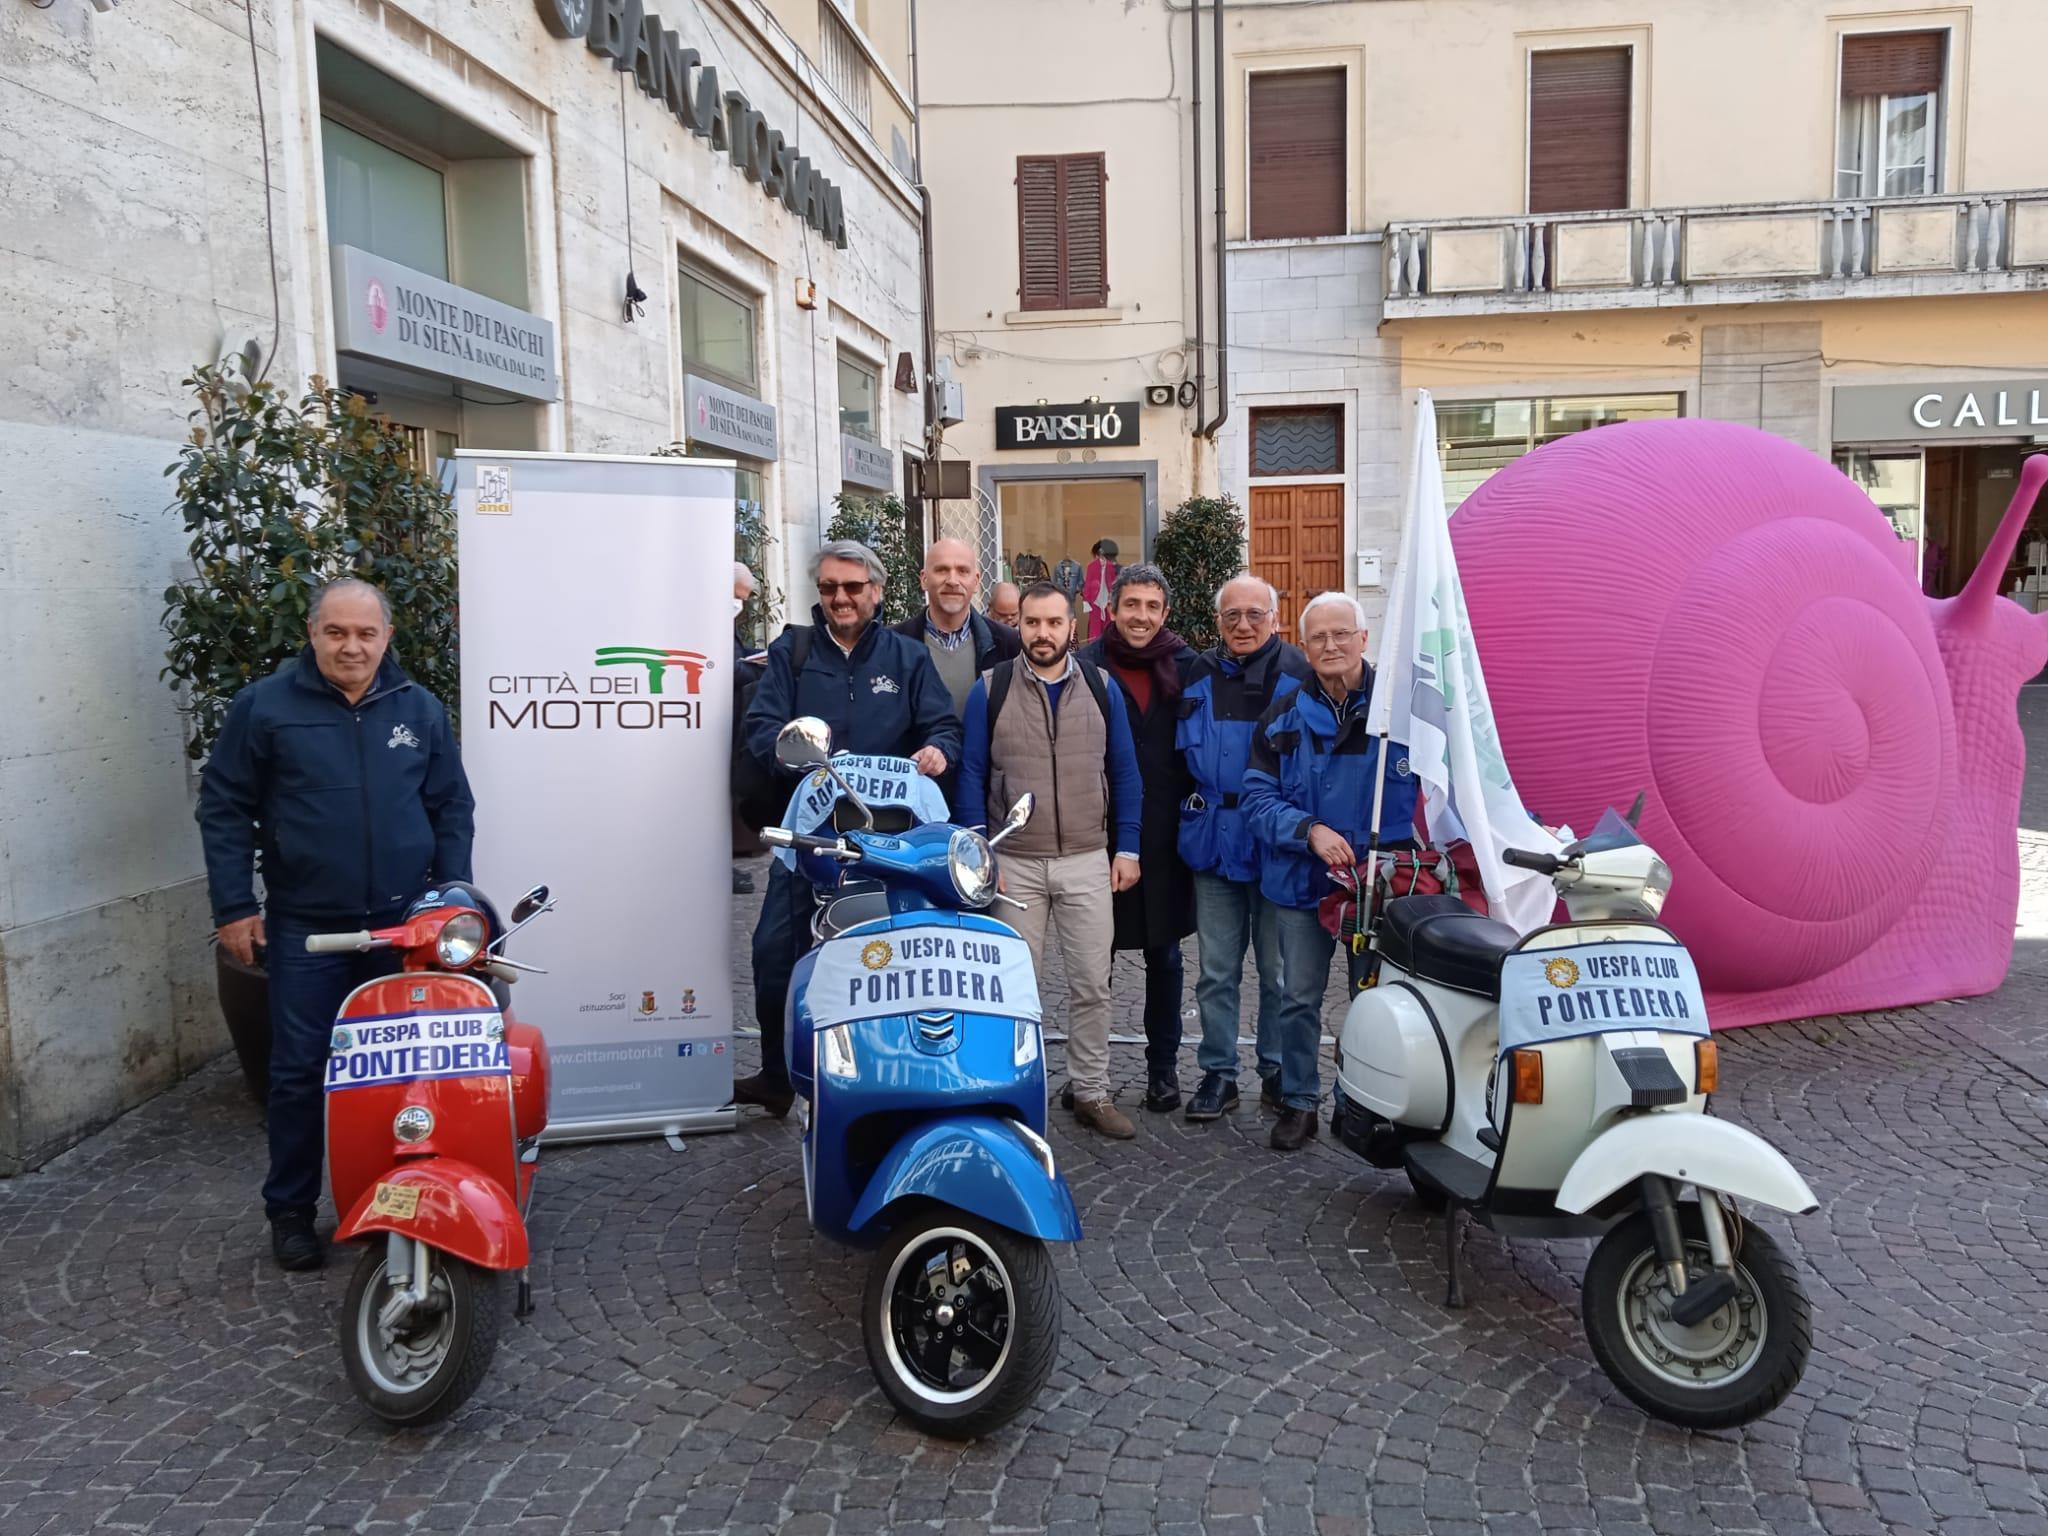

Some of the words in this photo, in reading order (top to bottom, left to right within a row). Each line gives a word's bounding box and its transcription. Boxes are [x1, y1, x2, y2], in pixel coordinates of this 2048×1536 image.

[586, 0, 729, 151] BANCA
[722, 90, 848, 250] TOSCANA
[395, 285, 459, 330] MONTE
[462, 308, 491, 341] DEI
[493, 320, 545, 358] PASCHI
[397, 315, 420, 346] DI
[423, 323, 475, 362] SIENA
[475, 347, 510, 372] BANCA
[509, 358, 528, 377] DAL
[529, 364, 546, 382] 1472
[708, 395, 735, 419] MONTE
[735, 405, 749, 424] DEI
[749, 409, 772, 433] PASCHI
[709, 414, 719, 432] DI
[720, 418, 742, 439] SIENA
[1013, 405, 1122, 442] BARSHÓ
[1913, 390, 2048, 428] CALL
[488, 671, 579, 694] CITTÀ
[590, 676, 638, 694] DEI
[489, 700, 701, 730] MOTORI
[877, 757, 911, 774] CLUB
[900, 938, 957, 960] VESPA
[962, 942, 1001, 965] CLUB
[1586, 956, 1642, 979] VESPA
[1645, 957, 1681, 980] CLUB
[608, 993, 626, 1001] Soci
[849, 968, 1005, 1006] PONTEDERA
[1537, 988, 1690, 1026] PONTEDERA
[356, 1022, 421, 1046] VESPA
[428, 1019, 483, 1039] CLUB
[328, 1042, 511, 1082] PONTEDERA
